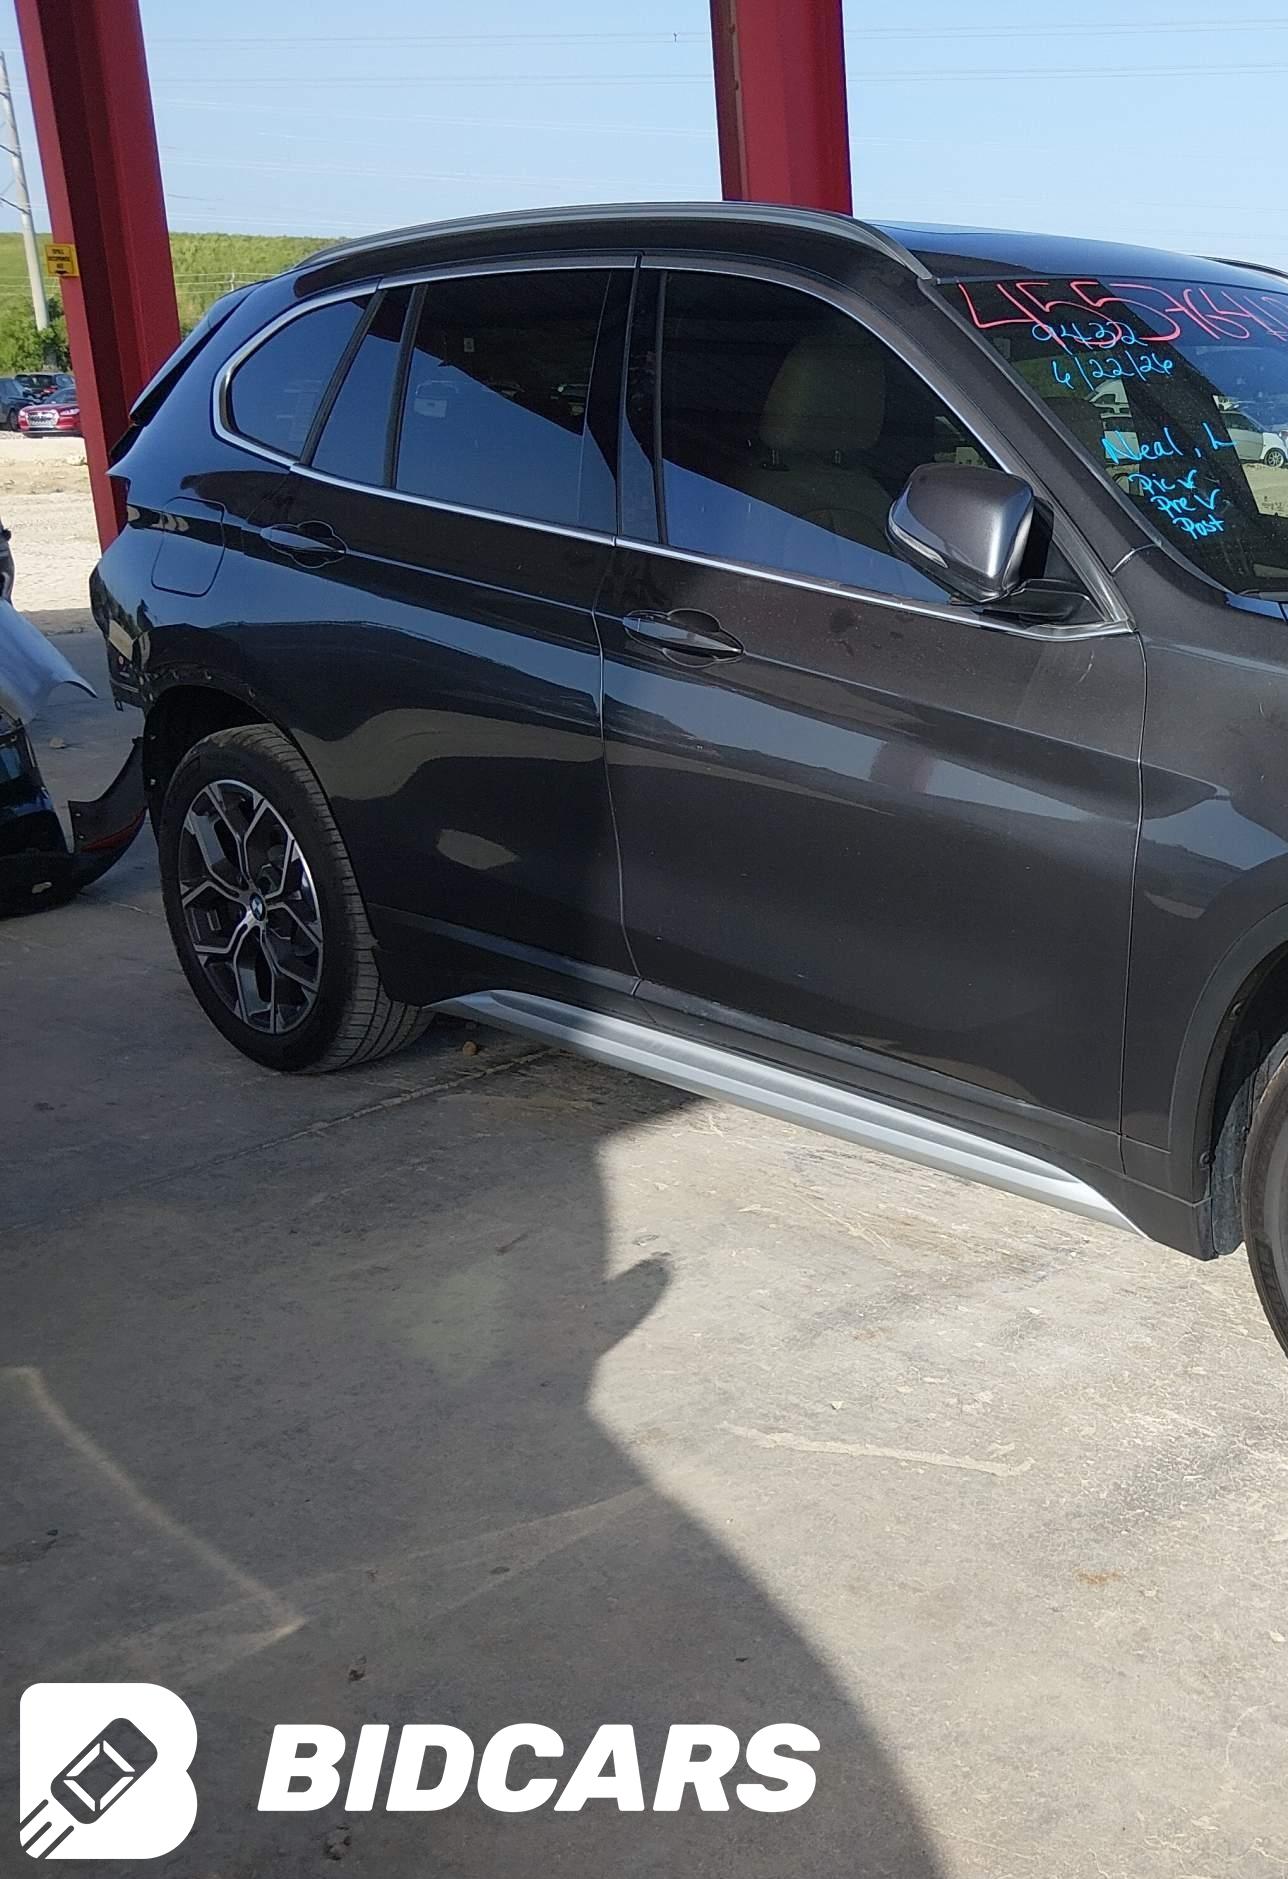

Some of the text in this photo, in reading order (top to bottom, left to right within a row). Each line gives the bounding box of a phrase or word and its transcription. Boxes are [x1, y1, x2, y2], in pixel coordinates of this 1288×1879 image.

[1031, 321, 1149, 356] 9432
[1052, 350, 1173, 391] 6/22/26
[1127, 473, 1176, 495] Pic
[1150, 495, 1197, 519] Pre
[1172, 514, 1225, 539] Post
